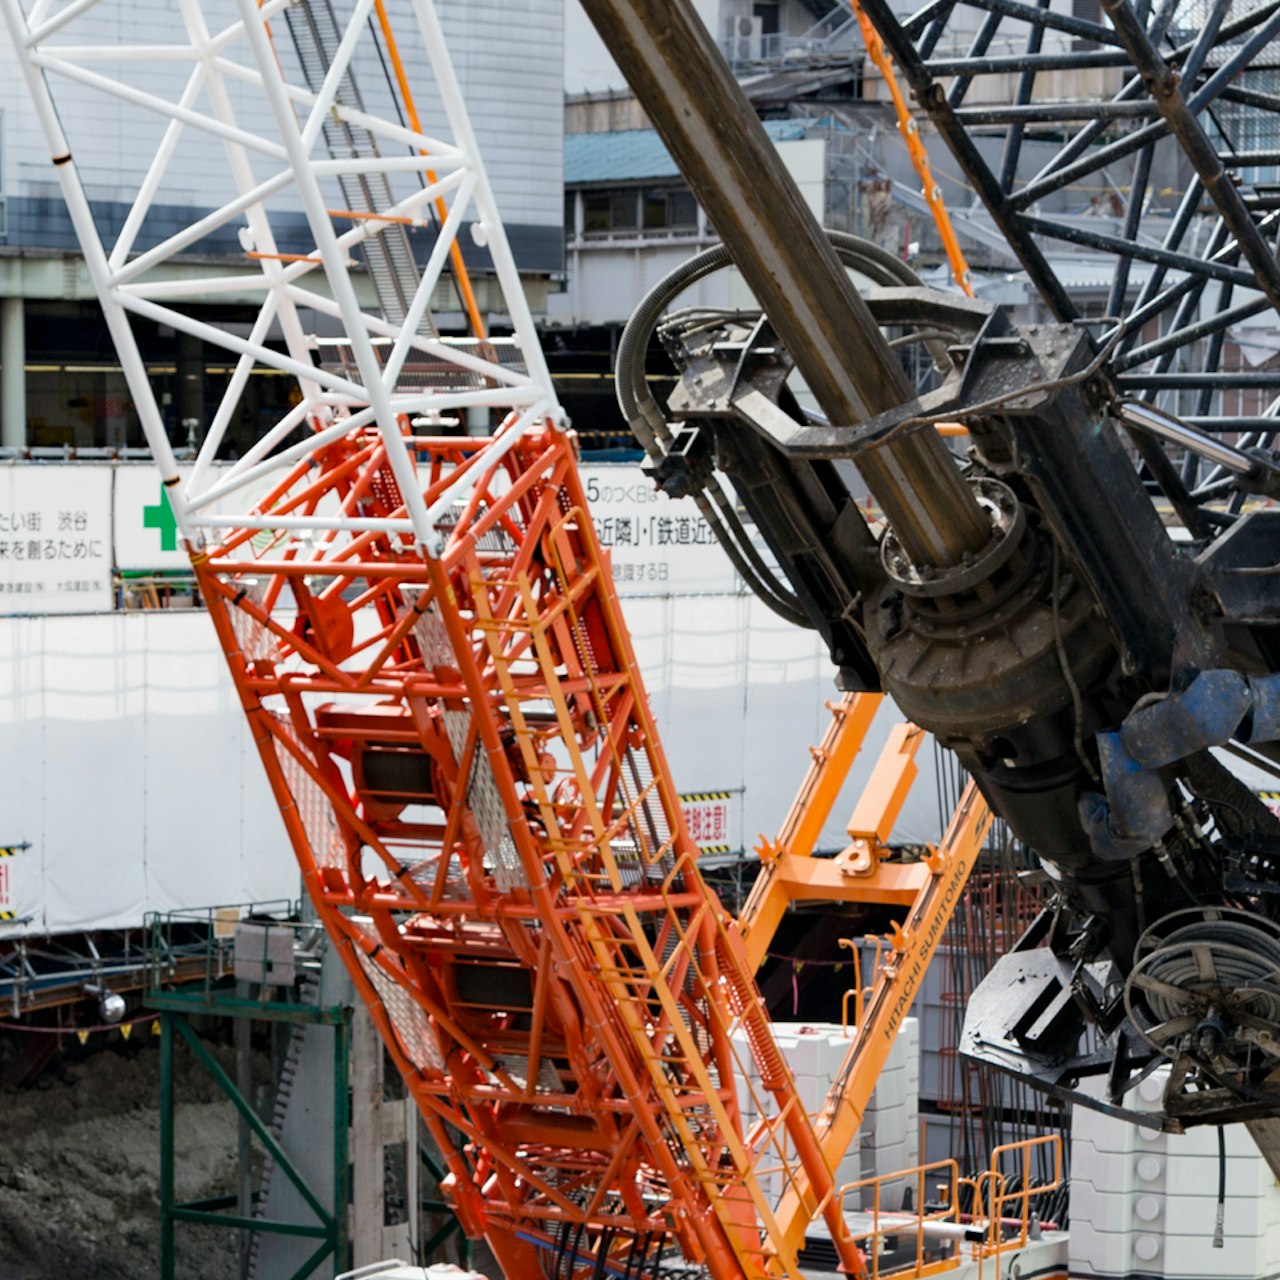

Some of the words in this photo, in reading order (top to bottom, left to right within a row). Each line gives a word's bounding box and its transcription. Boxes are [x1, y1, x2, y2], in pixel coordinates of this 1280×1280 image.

[58, 511, 88, 532] 渋谷
[884, 962, 922, 1040] HITACHI
[919, 860, 966, 961] SUMITOMO
